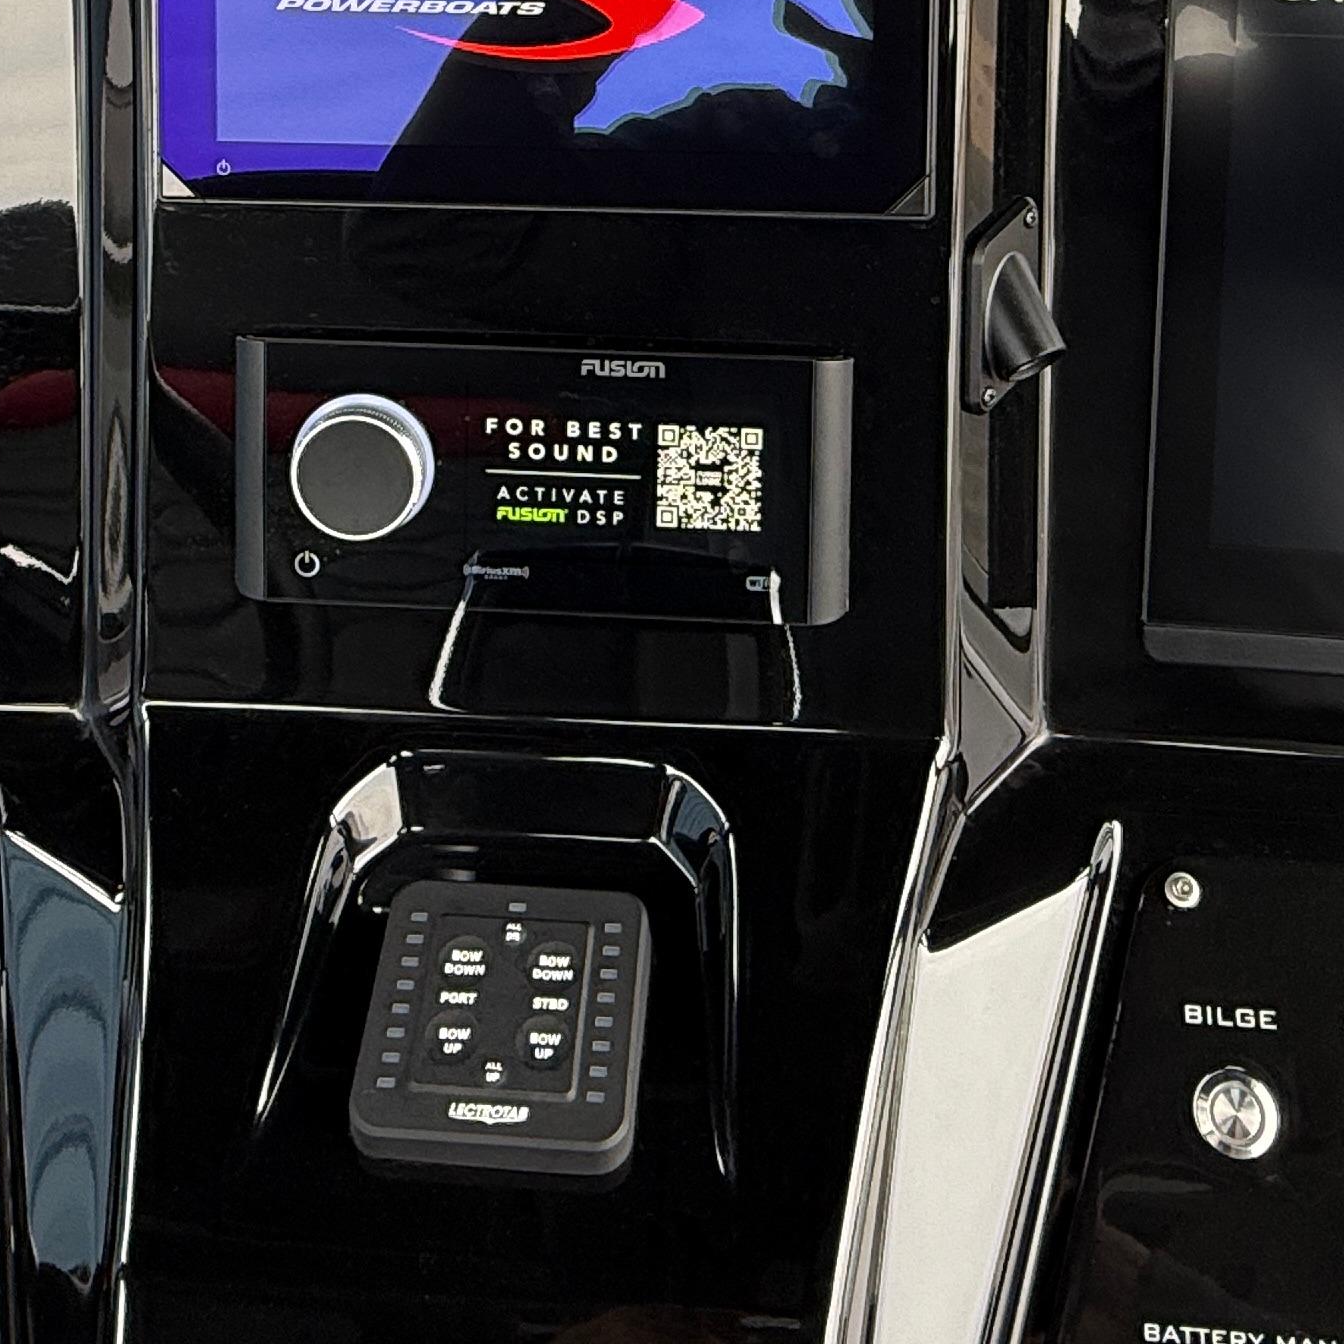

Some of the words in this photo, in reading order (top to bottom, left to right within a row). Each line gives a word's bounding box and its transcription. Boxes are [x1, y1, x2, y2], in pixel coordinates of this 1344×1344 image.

[580, 359, 666, 379] FUSION
[485, 417, 546, 436] FOR
[567, 420, 642, 440] BEST
[508, 442, 618, 463] SOUND
[496, 485, 625, 505] ACTIVATE
[496, 507, 568, 523] FUSION
[576, 509, 624, 525] DSP
[451, 949, 484, 962] BOW
[539, 955, 570, 968] BOW
[444, 963, 485, 976] DOWN
[532, 969, 573, 981] DOWN
[440, 992, 477, 1005] PORT
[1184, 1004, 1278, 1031] BILGE
[439, 1027, 471, 1041] BOW
[529, 1032, 561, 1047] BOW
[443, 1042, 463, 1054] UP
[534, 1047, 554, 1060] UP
